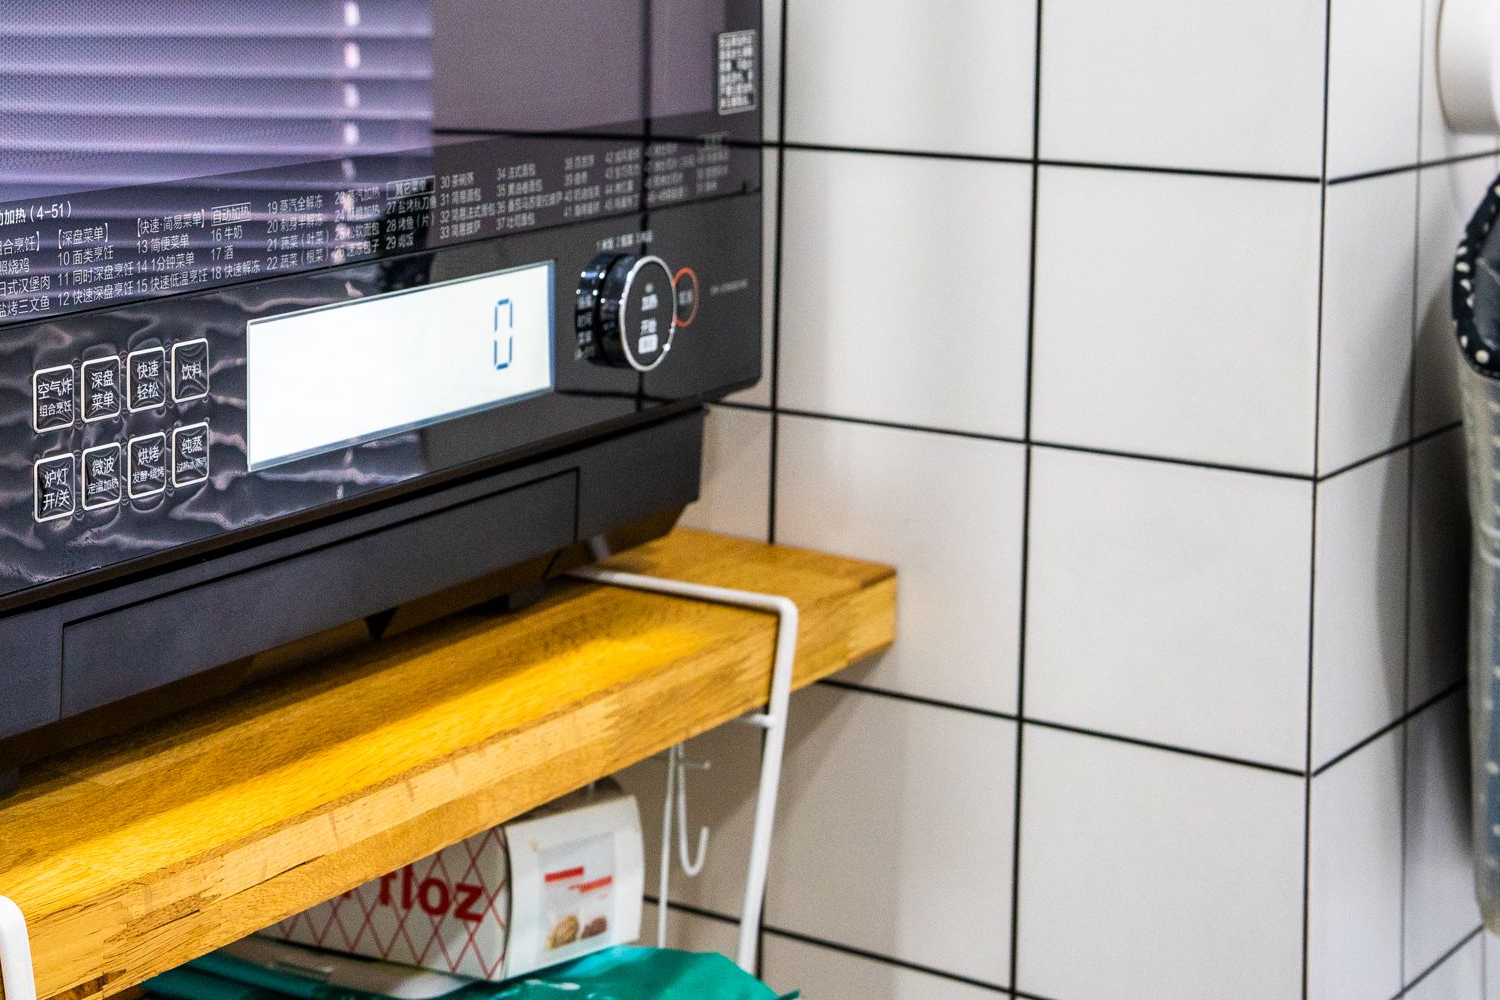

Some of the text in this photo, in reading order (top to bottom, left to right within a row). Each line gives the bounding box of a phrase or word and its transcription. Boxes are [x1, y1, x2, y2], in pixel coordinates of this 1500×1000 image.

[440, 176, 450, 189] 30
[268, 195, 323, 214] 19 蒸汽全解冻
[387, 202, 396, 214] 27
[440, 193, 449, 206] 31
[213, 206, 249, 223] 自动加热
[440, 211, 449, 223] 32
[211, 225, 242, 242] 16 牛奶
[267, 220, 278, 233] 20
[386, 220, 396, 232] 28
[440, 226, 449, 239] 33
[137, 234, 189, 253] 13 简便菜单
[267, 239, 277, 251] 21
[386, 237, 396, 249] 29
[58, 245, 114, 265] 10 面类烹饪
[211, 245, 233, 261] 17 酒
[137, 252, 194, 273] 14 1分钟菜单
[211, 260, 260, 279] 18 快速解冻
[267, 258, 277, 270] 22
[58, 262, 134, 286] 11 同时深盘烹饪
[137, 268, 208, 292] 15 快速低温烹饪
[58, 281, 133, 306] 12 快速深盘烹饪
[494, 298, 513, 370] 0
[137, 361, 159, 378] 快速
[181, 362, 202, 380] 饮料
[92, 370, 114, 388] 深盘
[38, 378, 72, 400] 空气炸
[137, 382, 159, 400] 轻松
[40, 400, 72, 417] 组合烹饪
[92, 392, 114, 411] 菜单
[182, 436, 203, 454] 纯蒸
[138, 447, 160, 466] 烘烤
[92, 457, 114, 477] 微波
[45, 468, 68, 488] 炉灯
[88, 478, 118, 495] 定温加热
[43, 489, 69, 510] 开/关
